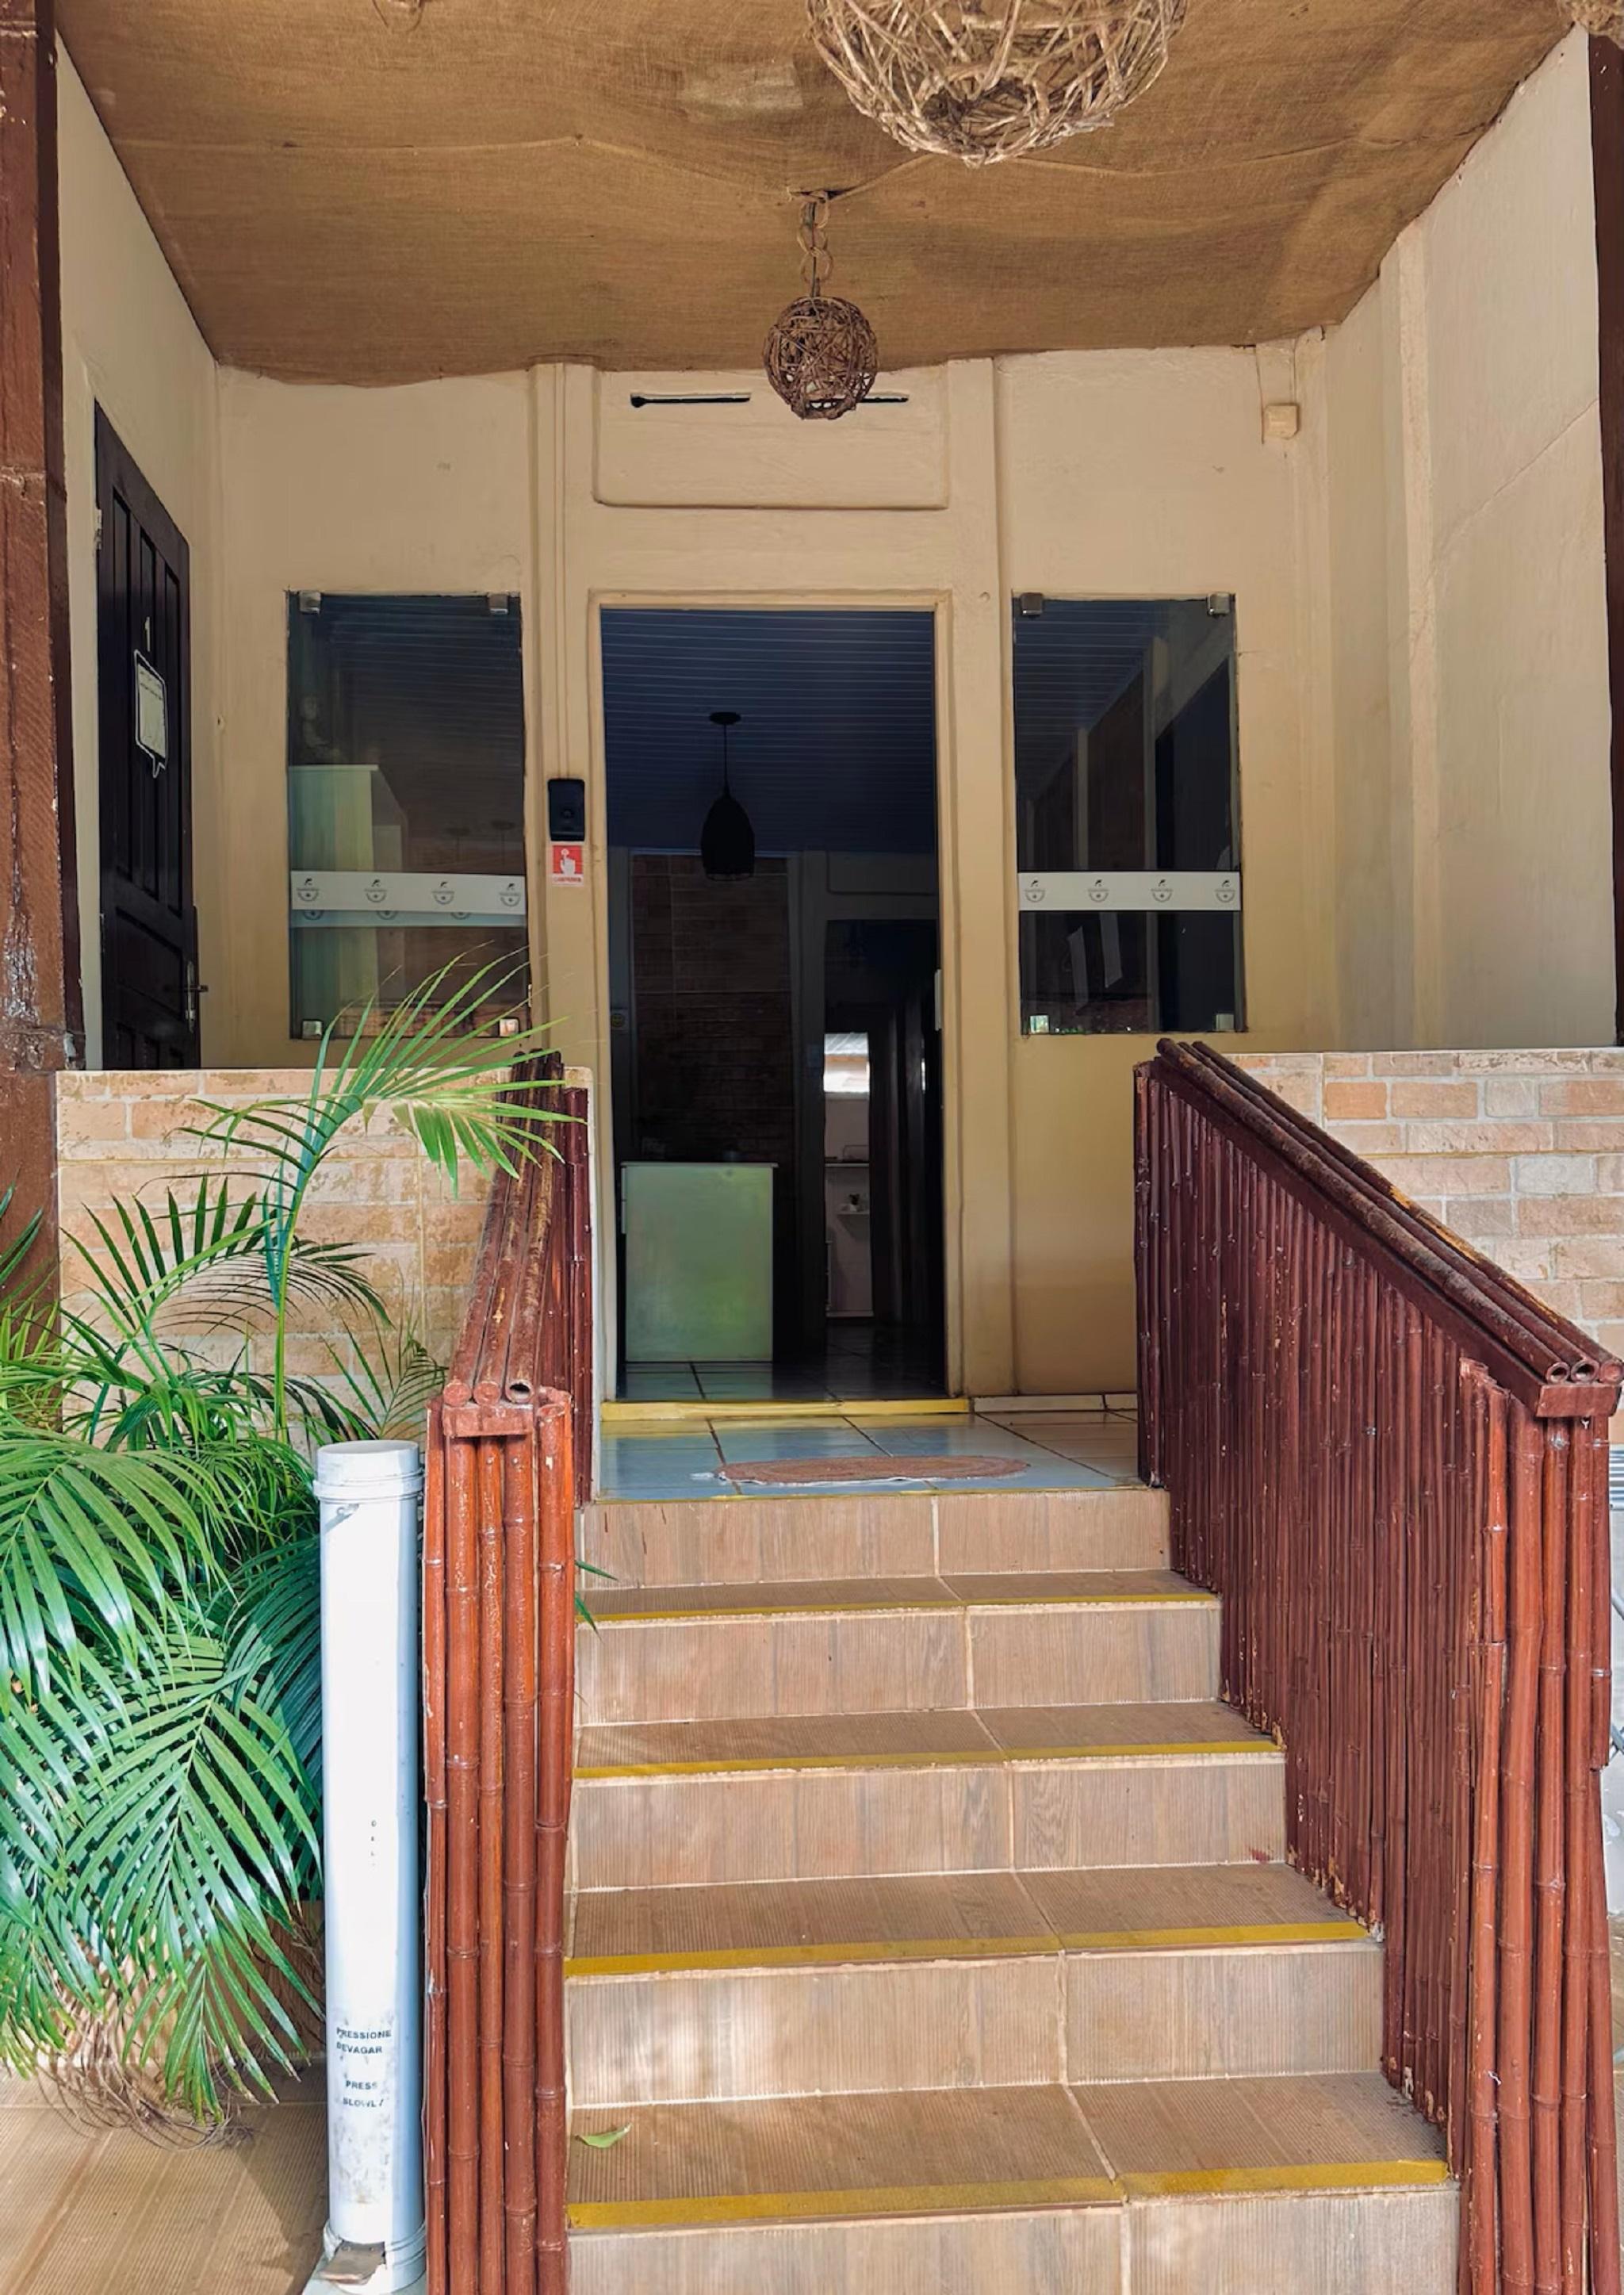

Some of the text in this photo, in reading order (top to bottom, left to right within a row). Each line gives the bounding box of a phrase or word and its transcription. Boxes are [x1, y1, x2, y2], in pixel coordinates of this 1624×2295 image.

[336, 2027, 392, 2039] PRESSIONE
[336, 2041, 381, 2054] DEVAGAR
[346, 2079, 377, 2090] PRESS
